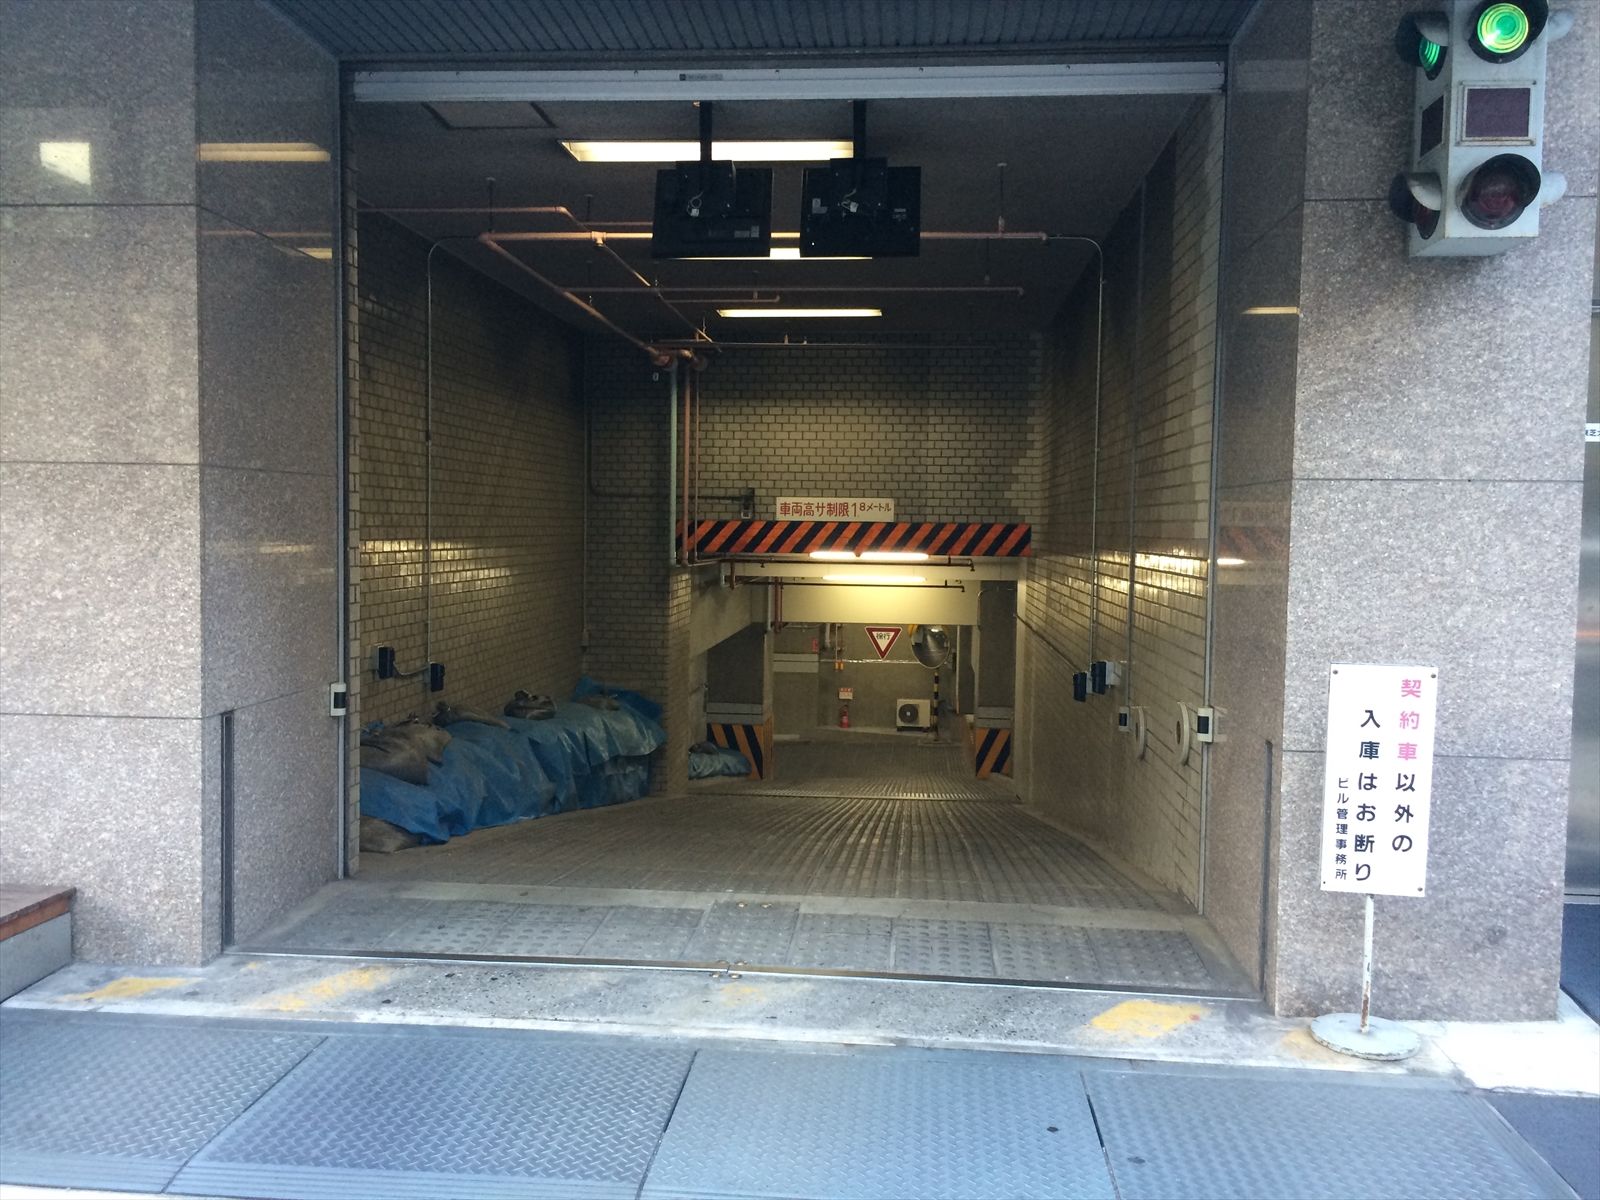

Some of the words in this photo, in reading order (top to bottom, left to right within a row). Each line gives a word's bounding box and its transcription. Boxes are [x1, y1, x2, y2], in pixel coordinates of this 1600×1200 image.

[1335, 777, 1350, 880] ビル管理事務所
[1354, 709, 1381, 881] 入庫はお断り
[1392, 678, 1422, 853] 契約車以外の
